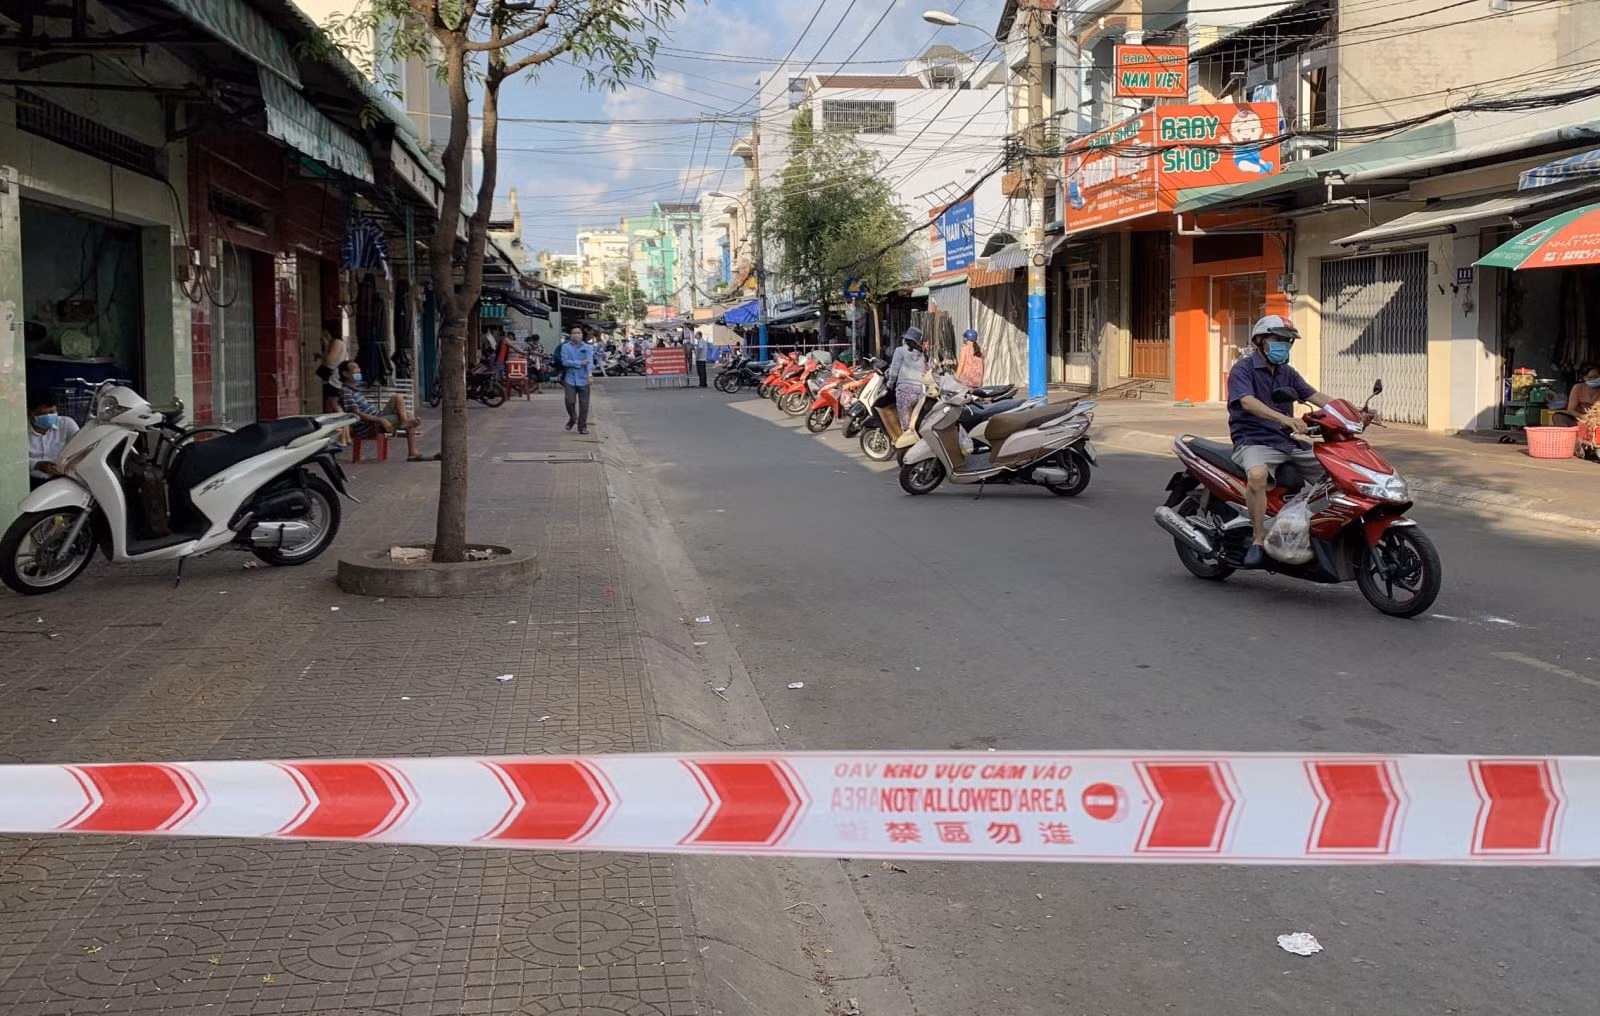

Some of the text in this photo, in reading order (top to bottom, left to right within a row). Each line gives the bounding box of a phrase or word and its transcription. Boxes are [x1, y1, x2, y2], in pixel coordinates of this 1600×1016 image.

[1122, 68, 1183, 92] NAM VIỆT
[1162, 147, 1221, 173] SHOP
[1459, 269, 1471, 279] 111
[880, 788, 1067, 812] NOT ALLOWED AREA
